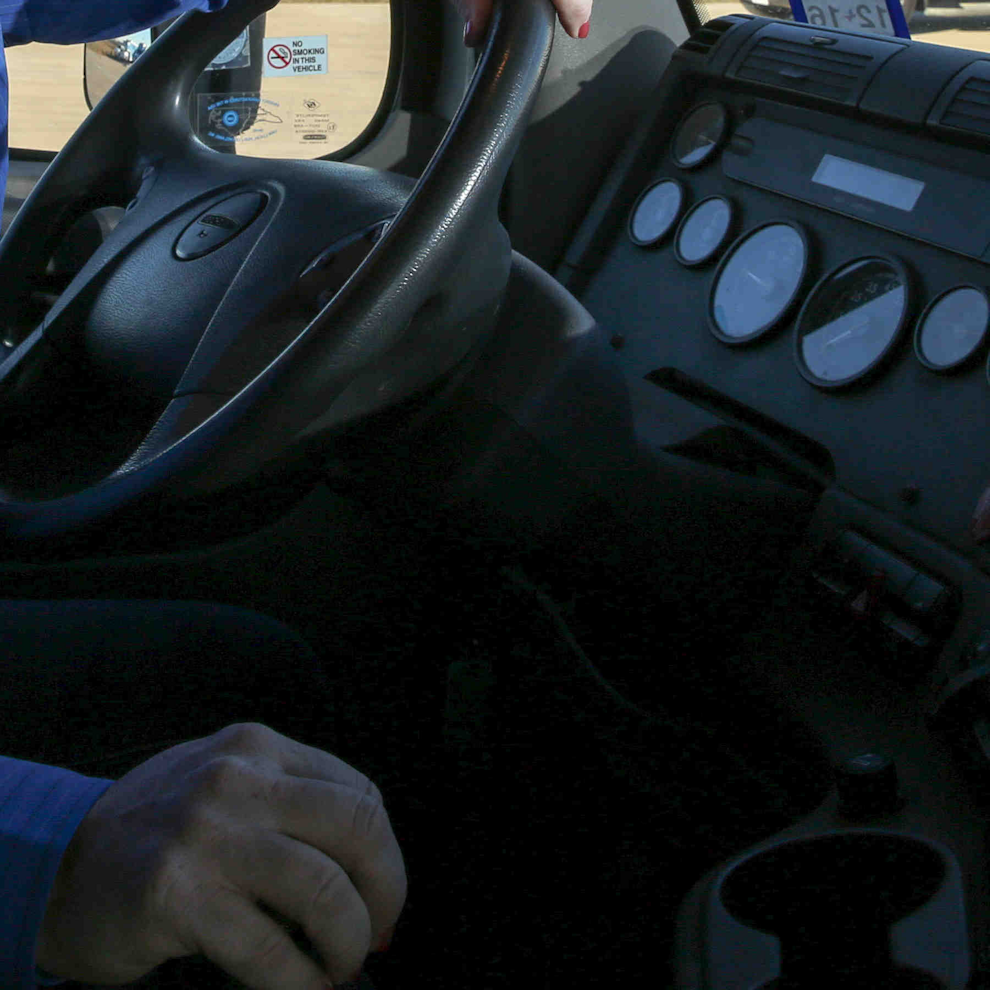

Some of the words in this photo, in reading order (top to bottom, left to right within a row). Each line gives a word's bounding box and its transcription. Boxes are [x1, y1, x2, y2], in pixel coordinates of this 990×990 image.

[292, 40, 303, 48] NO
[292, 47, 325, 56] SMOKING
[300, 56, 317, 64] THIS
[292, 64, 323, 73] VEHICLE
